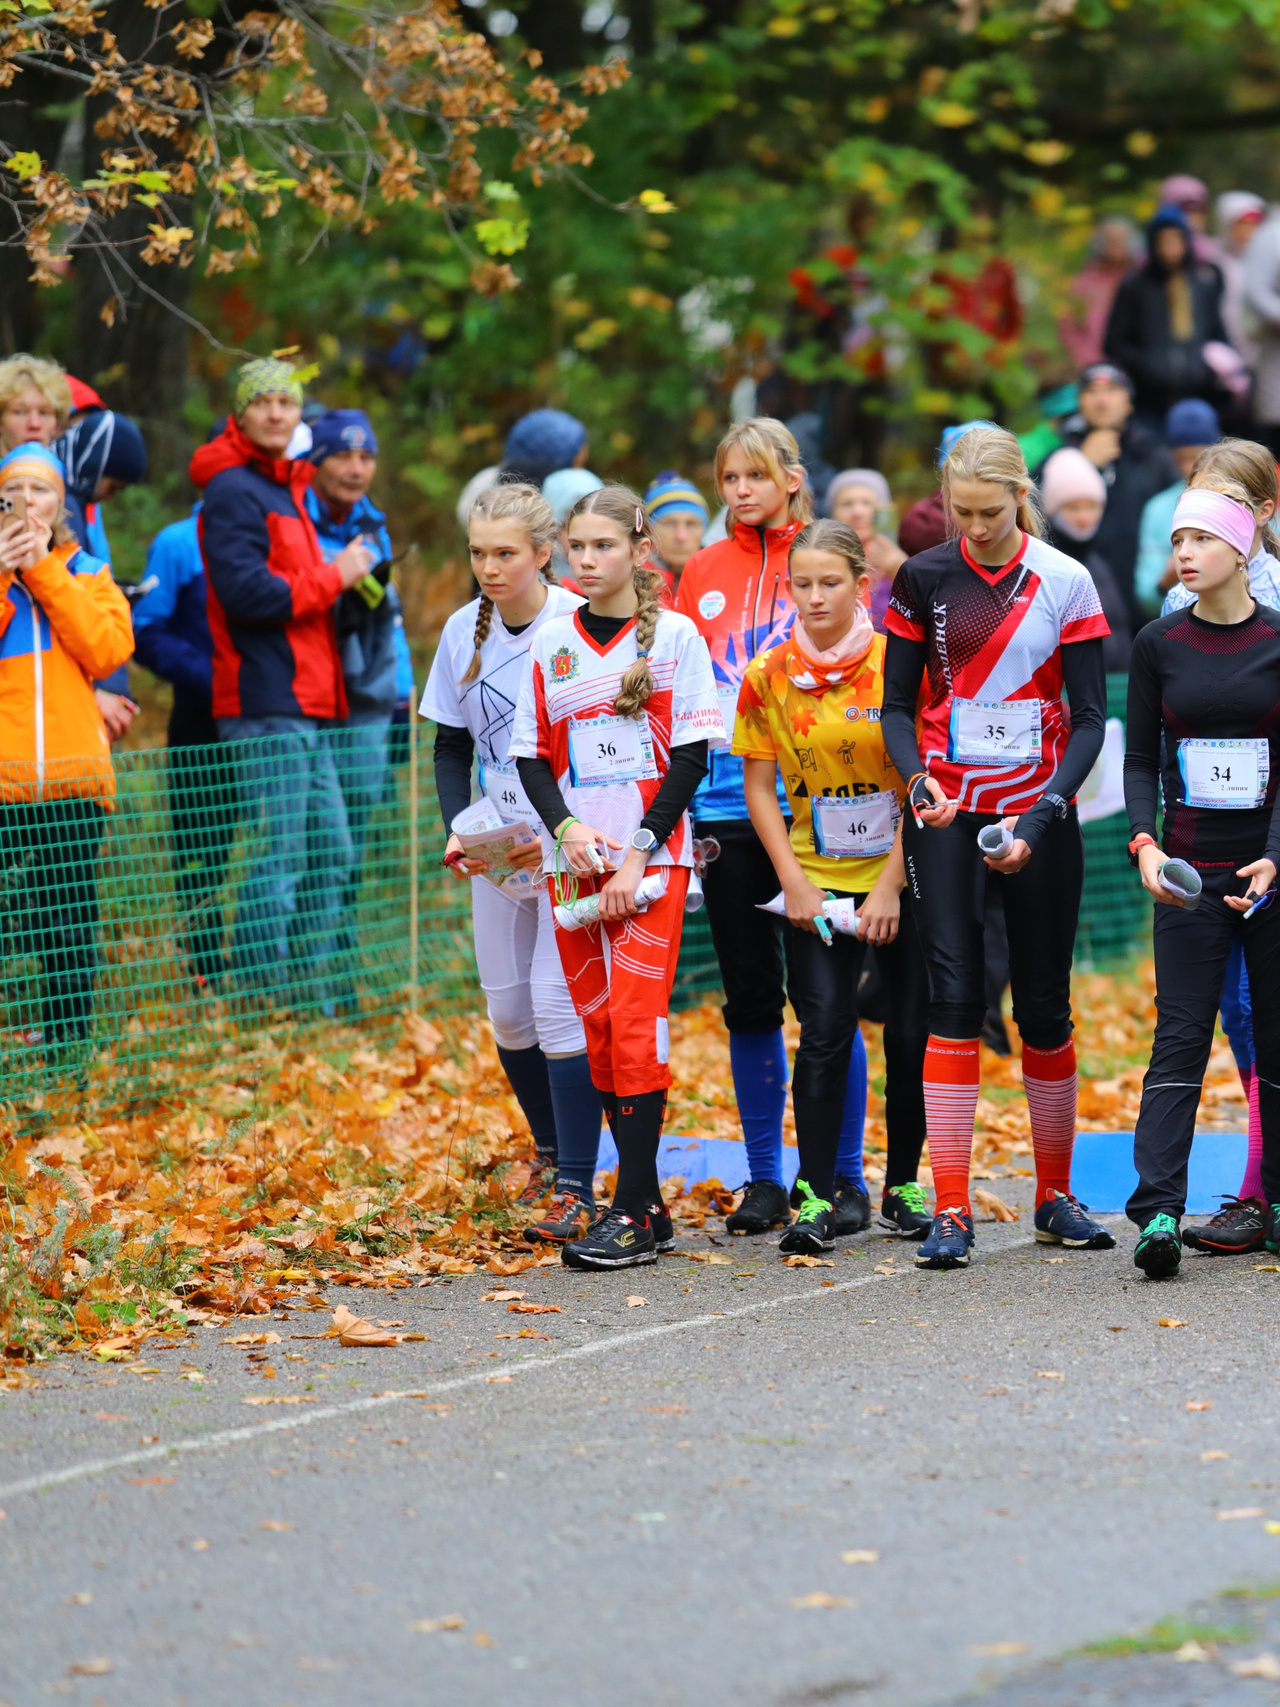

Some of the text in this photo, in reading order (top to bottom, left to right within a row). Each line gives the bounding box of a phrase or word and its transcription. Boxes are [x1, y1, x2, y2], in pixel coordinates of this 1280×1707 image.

[889, 596, 914, 619] ENSK
[984, 725, 1006, 740] 35
[596, 741, 617, 759] 36
[1210, 766, 1231, 781] 34
[501, 790, 517, 805] 48
[848, 820, 867, 836] 46
